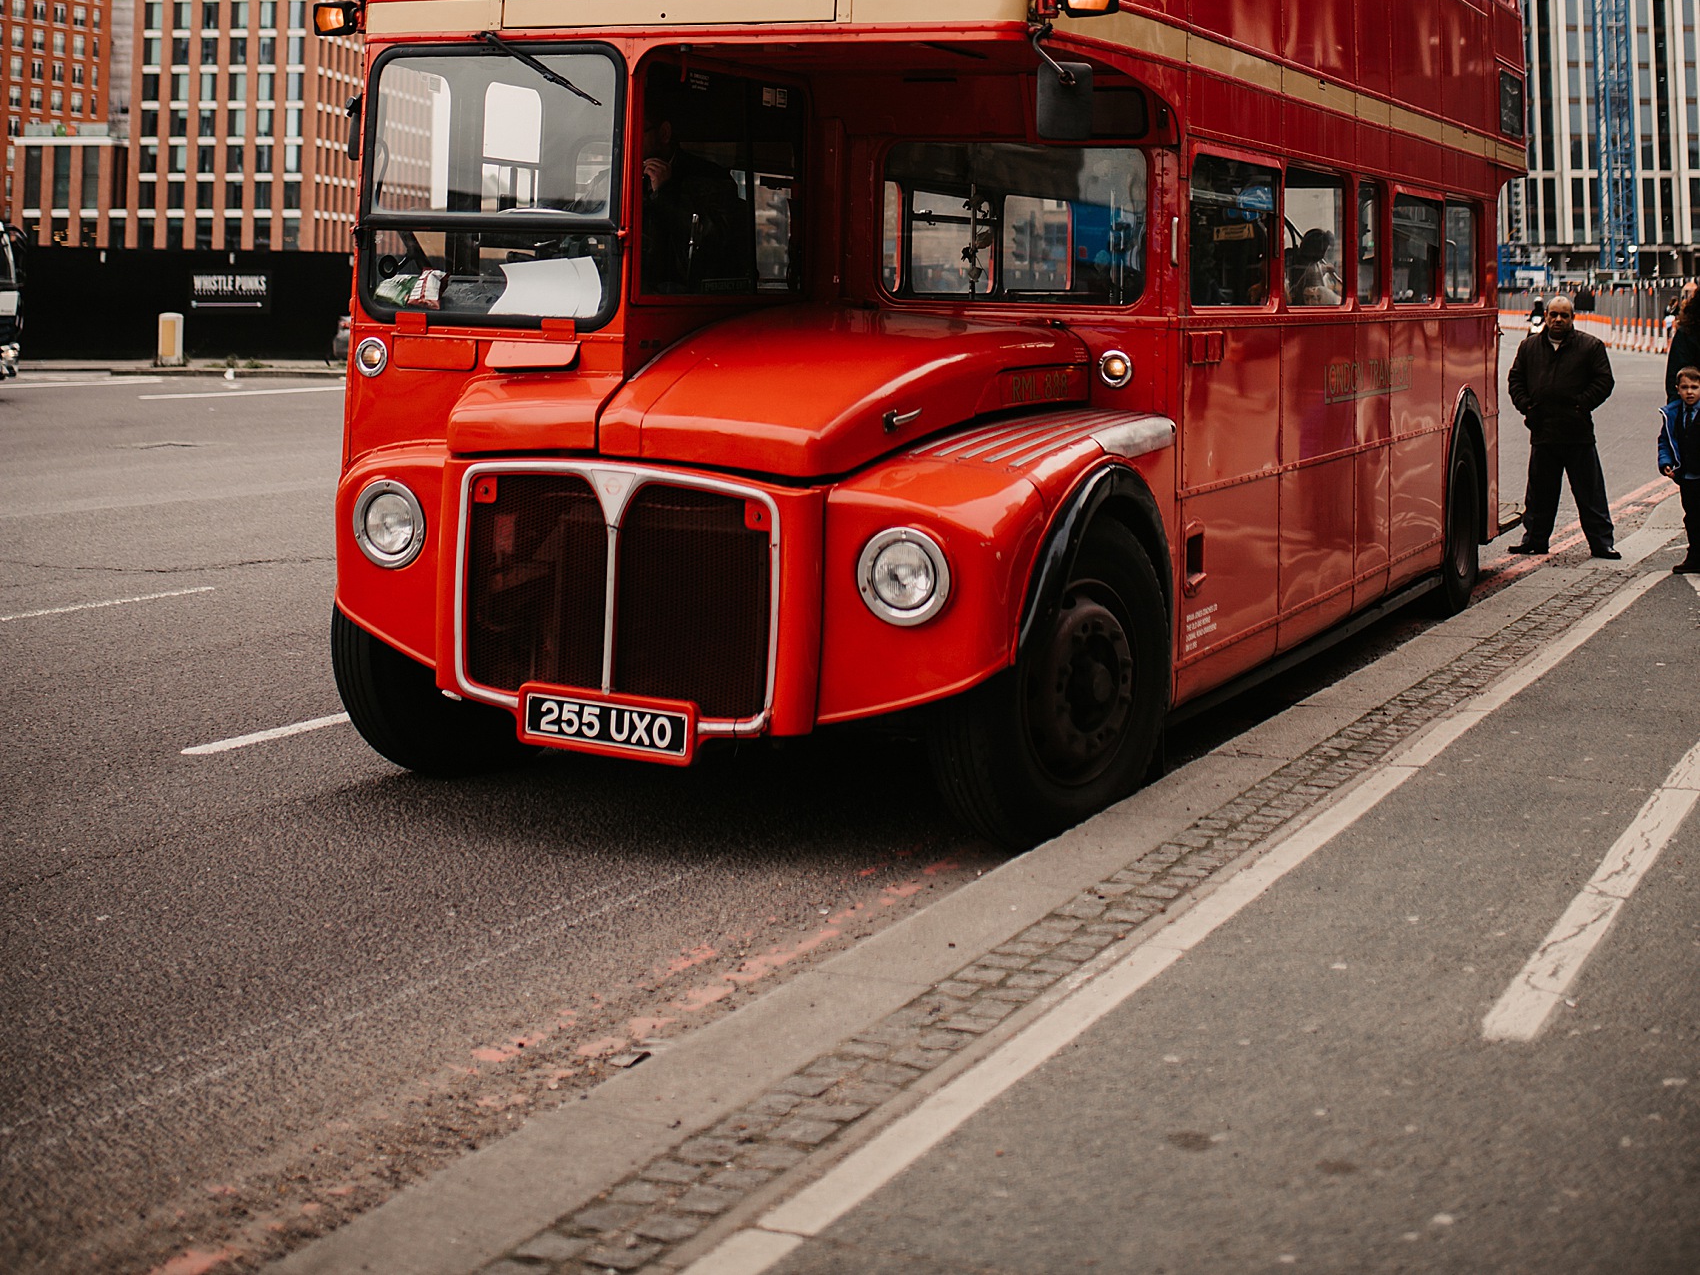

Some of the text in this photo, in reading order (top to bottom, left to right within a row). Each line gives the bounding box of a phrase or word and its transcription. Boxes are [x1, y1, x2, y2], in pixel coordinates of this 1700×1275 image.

[193, 275, 234, 291] WHISTLE
[1012, 373, 1068, 402] RML 888
[1324, 362, 1364, 405] LONDON
[540, 700, 672, 748] 255 UXO
